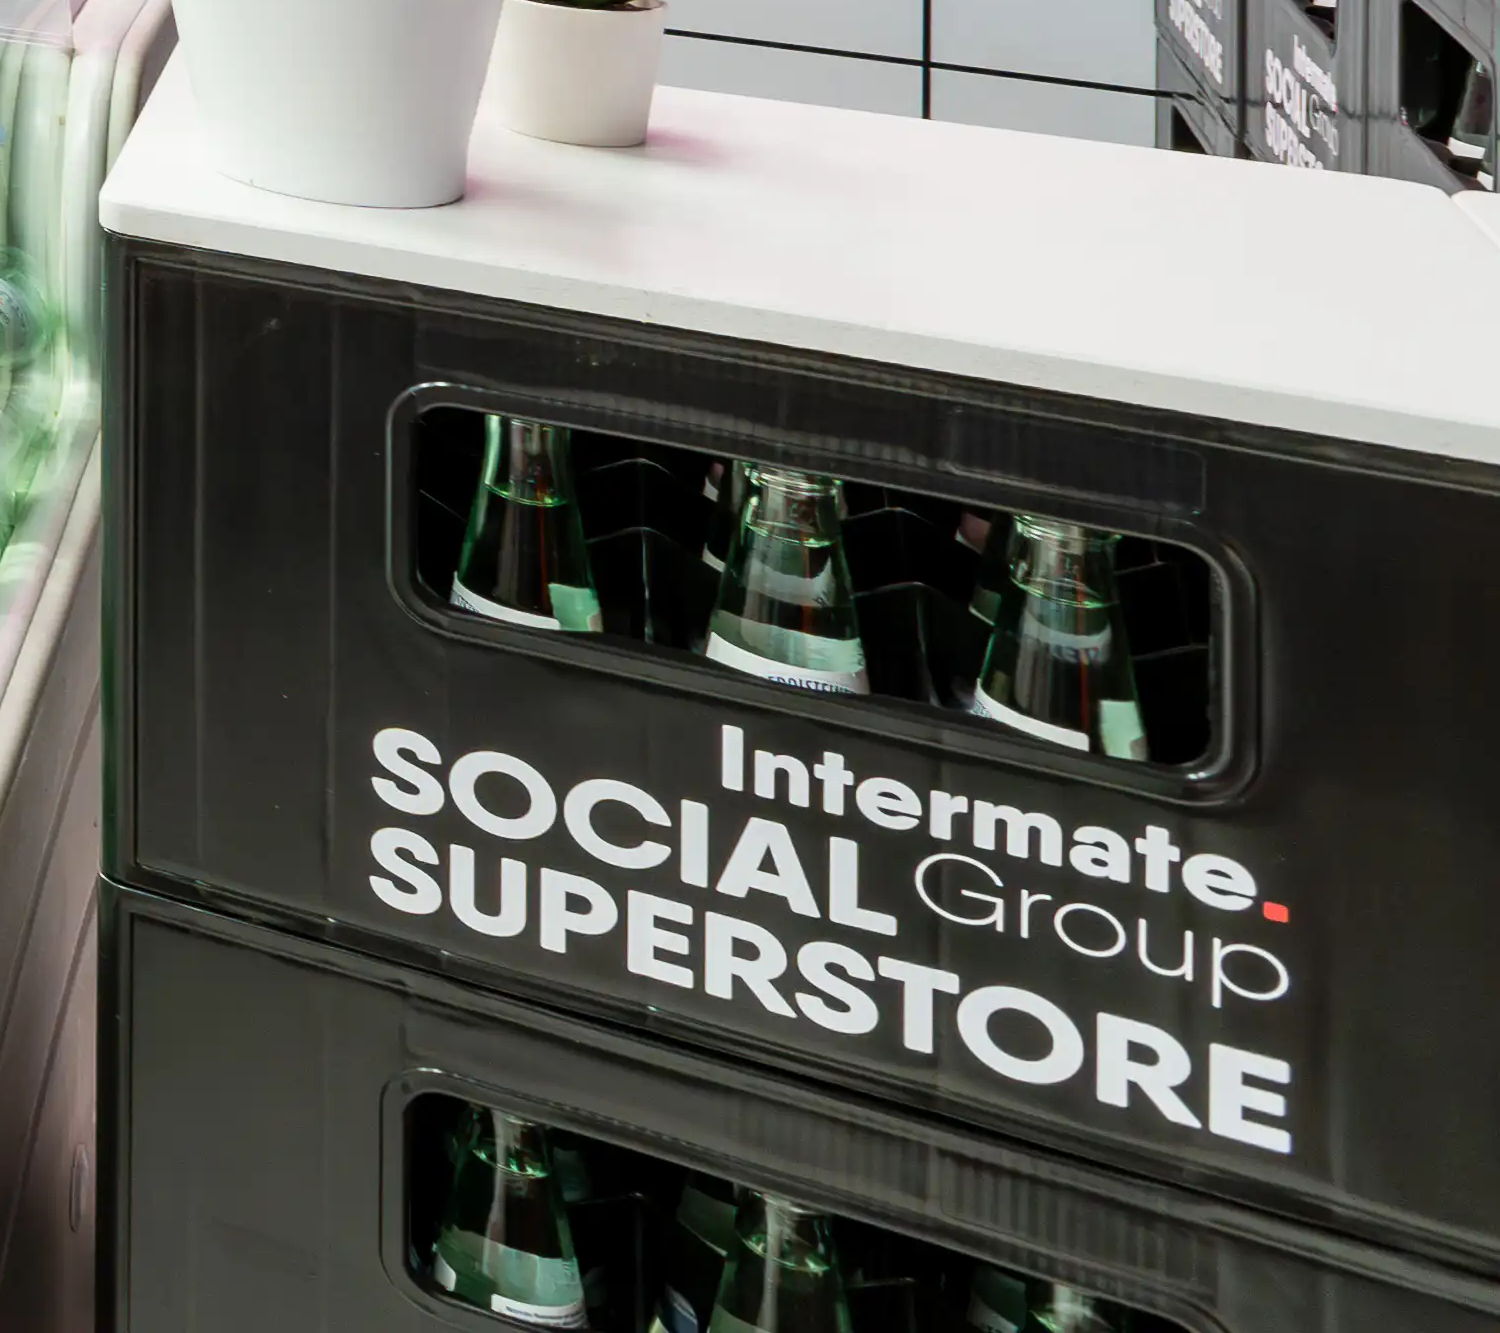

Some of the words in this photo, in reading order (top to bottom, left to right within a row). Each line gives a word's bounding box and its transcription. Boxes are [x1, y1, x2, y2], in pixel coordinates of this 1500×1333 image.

[369, 726, 898, 936] SOCIAL
[721, 724, 1290, 923] Intermate.
[368, 828, 1292, 1155] SUPERSTORE
[915, 853, 1290, 1008] Group
